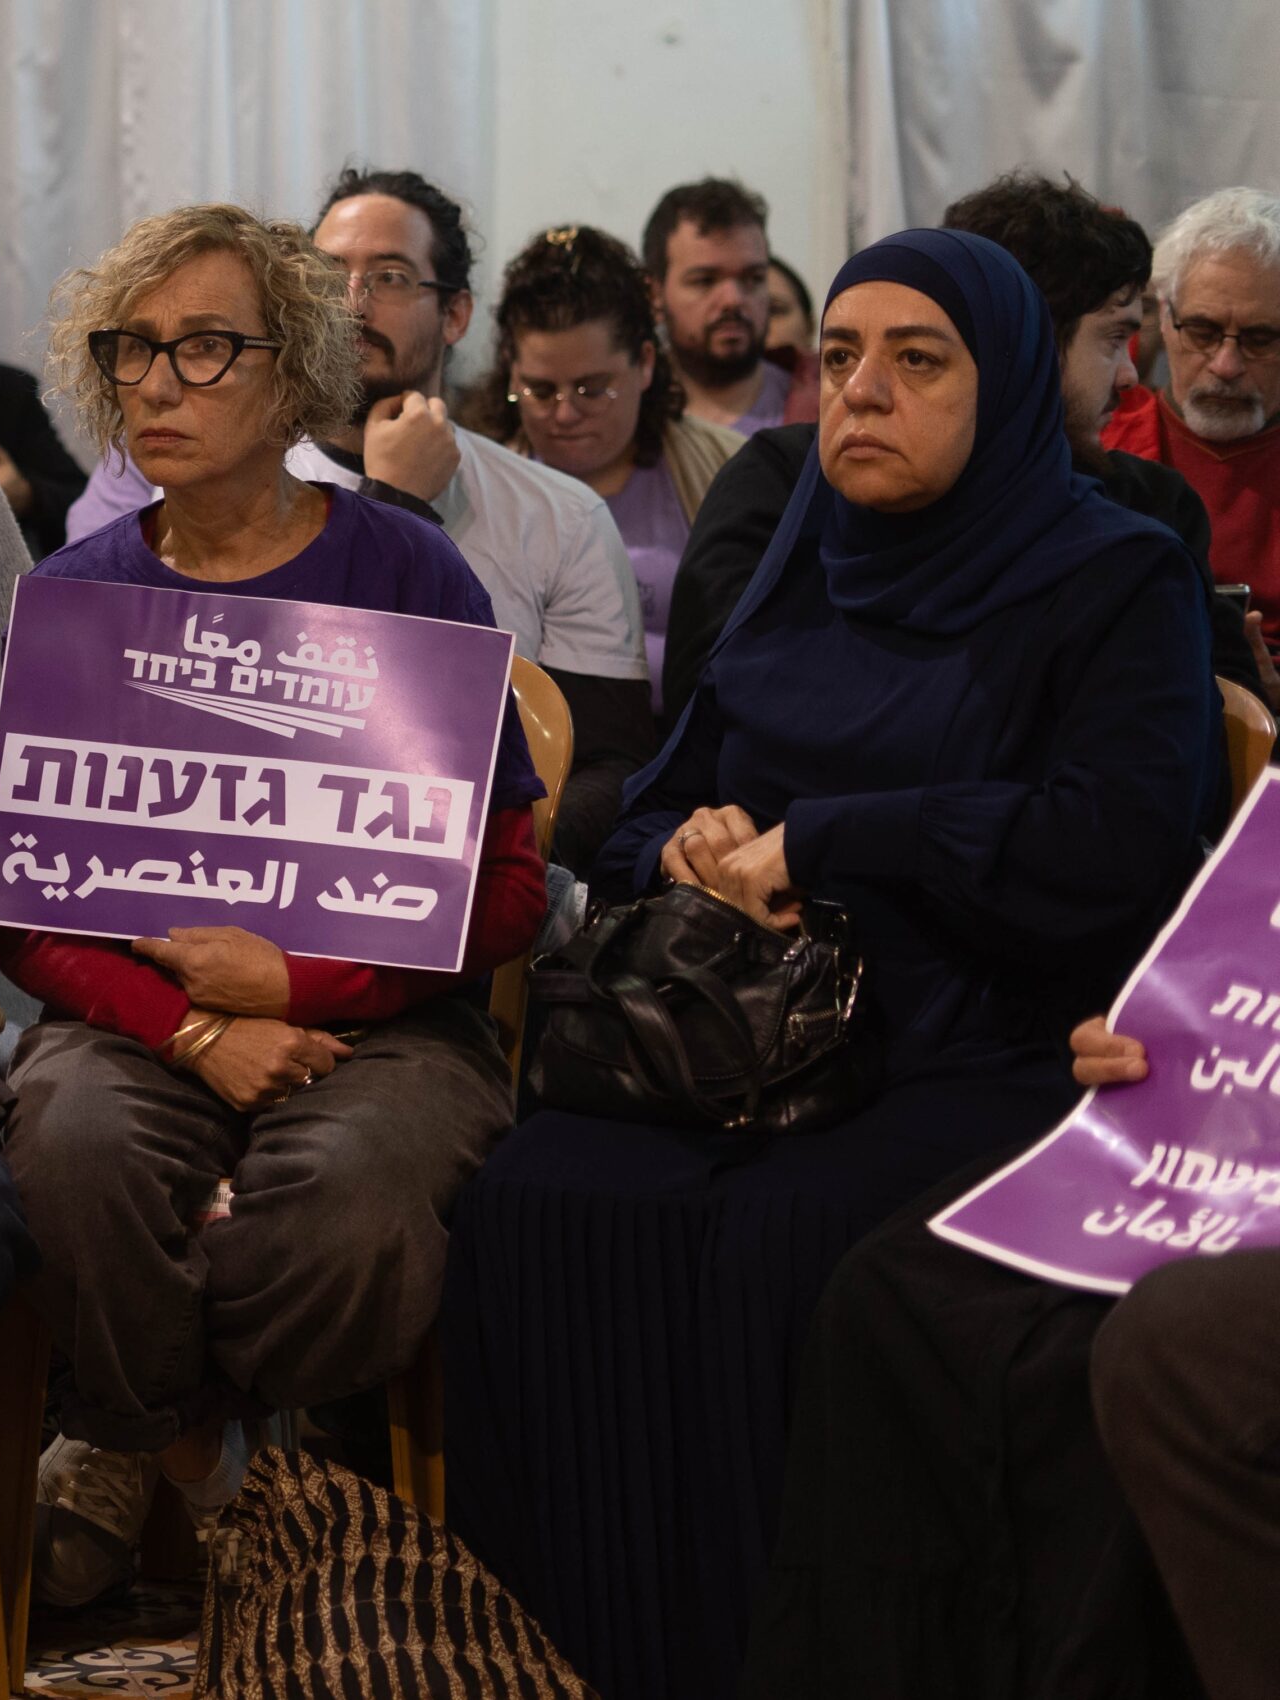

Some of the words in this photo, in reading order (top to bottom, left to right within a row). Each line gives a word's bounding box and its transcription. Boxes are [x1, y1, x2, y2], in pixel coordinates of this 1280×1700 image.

[123, 648, 218, 689] ביחד
[276, 631, 380, 680] نقف
[230, 664, 377, 712] עומדים
[11, 744, 287, 827] גזענות
[317, 773, 453, 845] נגד
[1, 832, 300, 910] العنصرية
[316, 872, 439, 922] ضد
